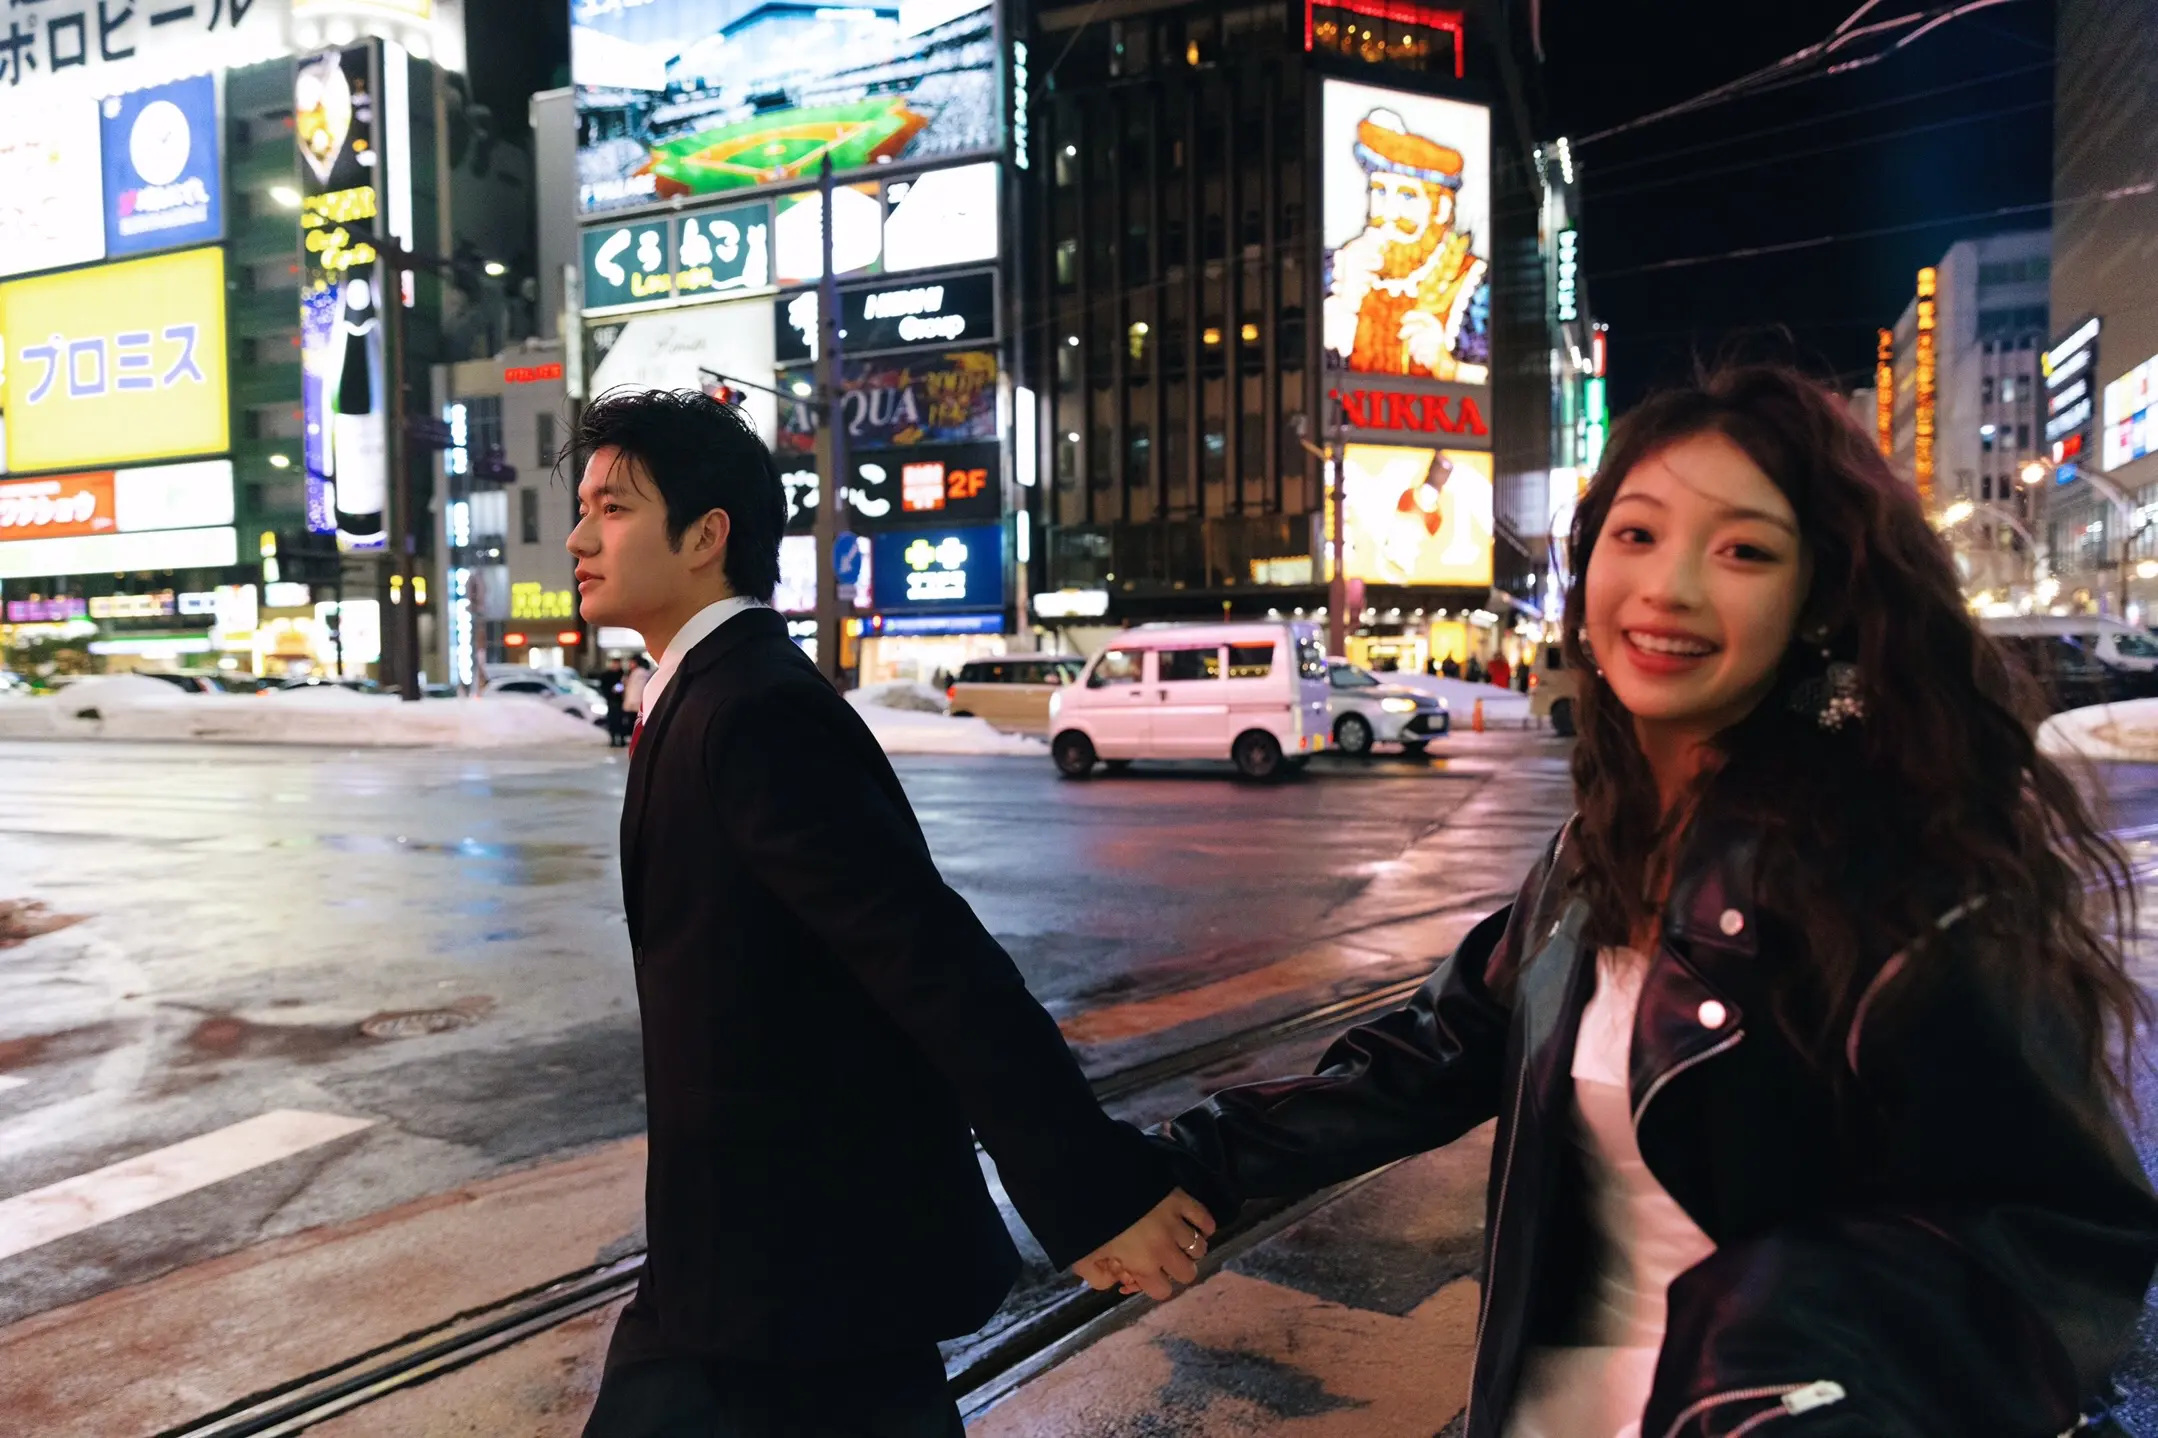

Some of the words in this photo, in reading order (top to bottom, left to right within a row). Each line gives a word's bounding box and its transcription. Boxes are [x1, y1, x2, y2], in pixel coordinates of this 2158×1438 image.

[20, 325, 205, 405] プロミス
[1328, 388, 1489, 436] NIKKA
[947, 468, 988, 499] 2F
